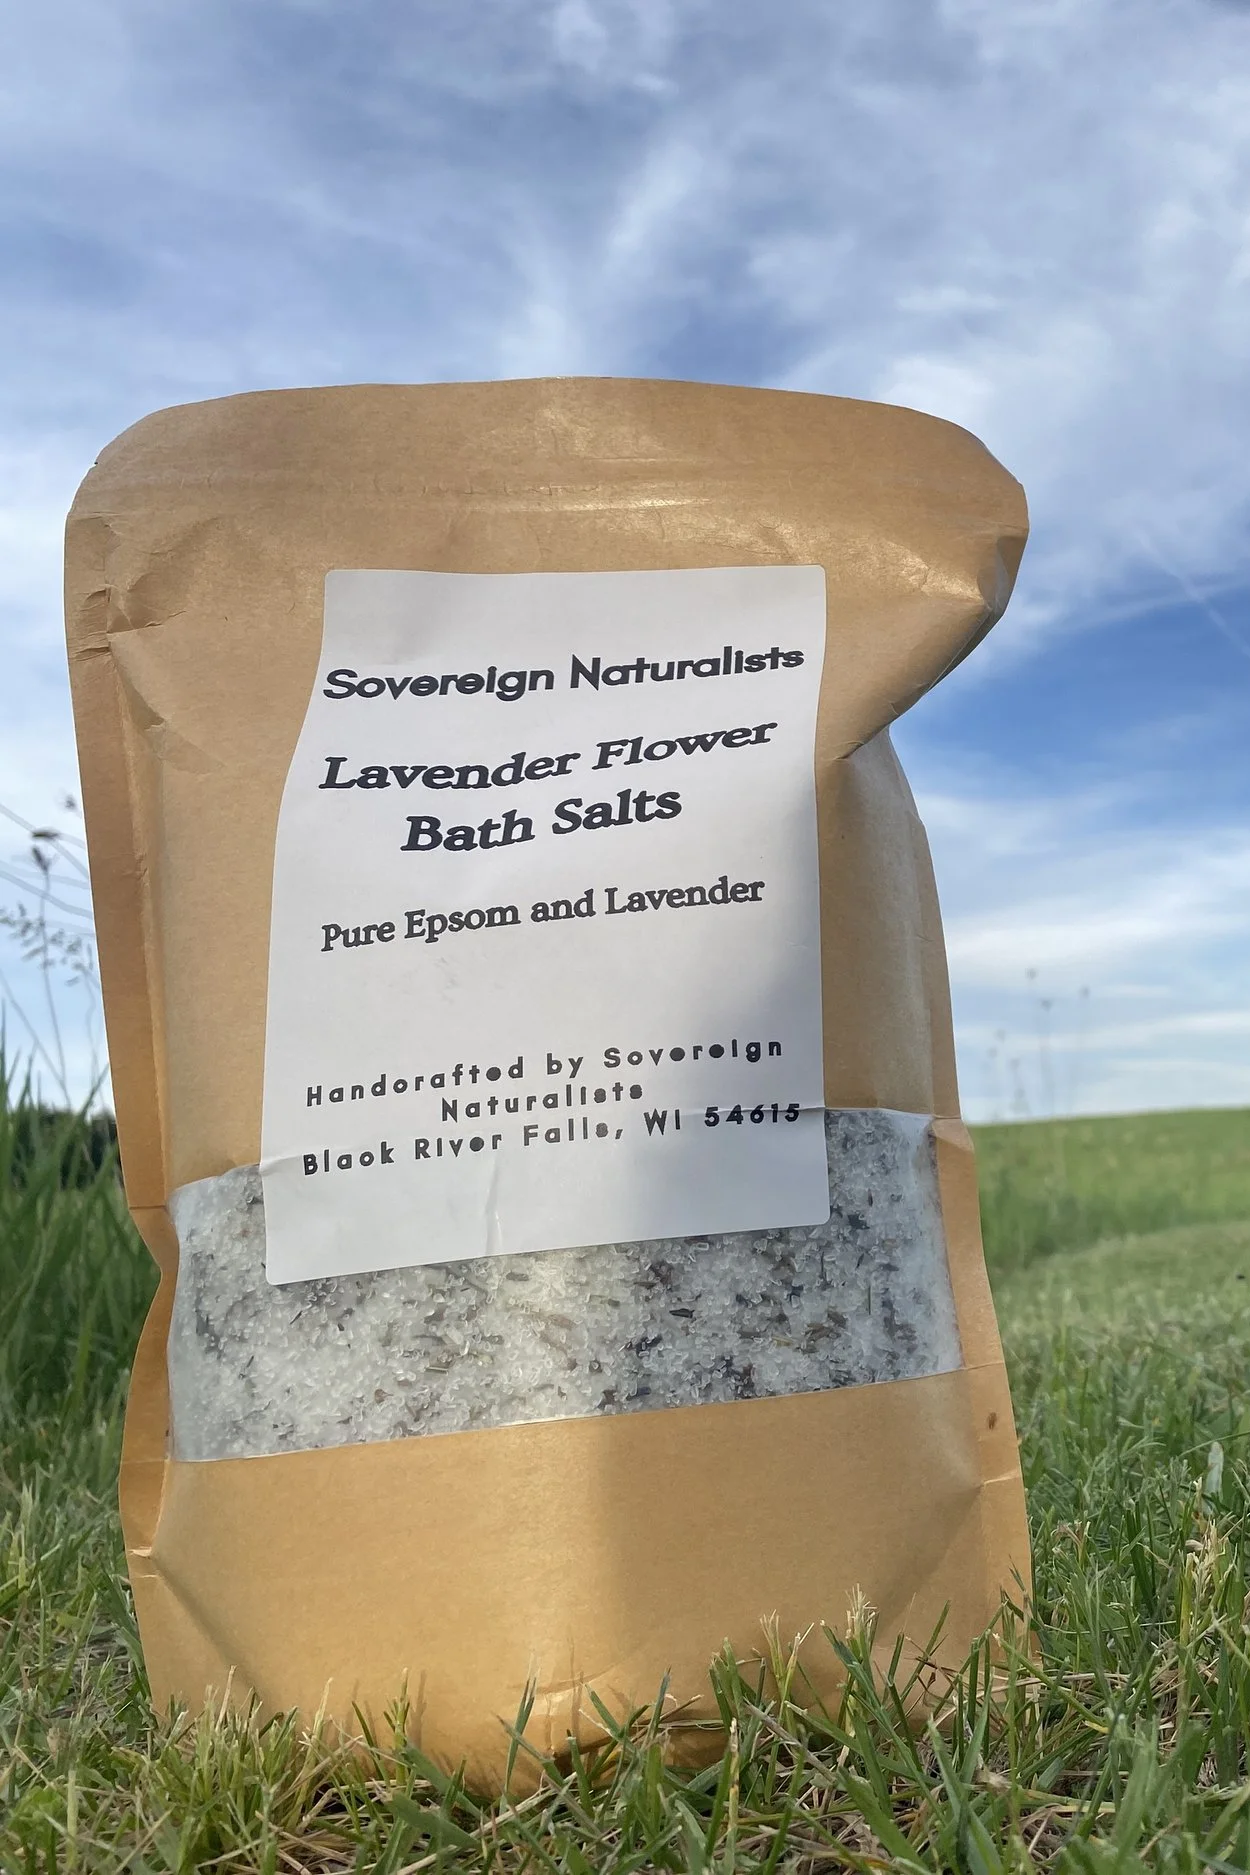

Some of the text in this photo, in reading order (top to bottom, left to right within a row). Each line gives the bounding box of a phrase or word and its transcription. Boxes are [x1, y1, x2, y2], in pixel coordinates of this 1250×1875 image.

[323, 645, 804, 702] Sovereign Naturalists
[319, 720, 779, 790] Lavender Flower
[401, 788, 682, 852] Bath Salts
[321, 876, 765, 952] Pure Epsom and Lavender
[306, 1038, 782, 1107] Handcrafted by Sovereign
[442, 1081, 643, 1122] Naturalists
[303, 1103, 800, 1176] Black River Falls, WI 54615
